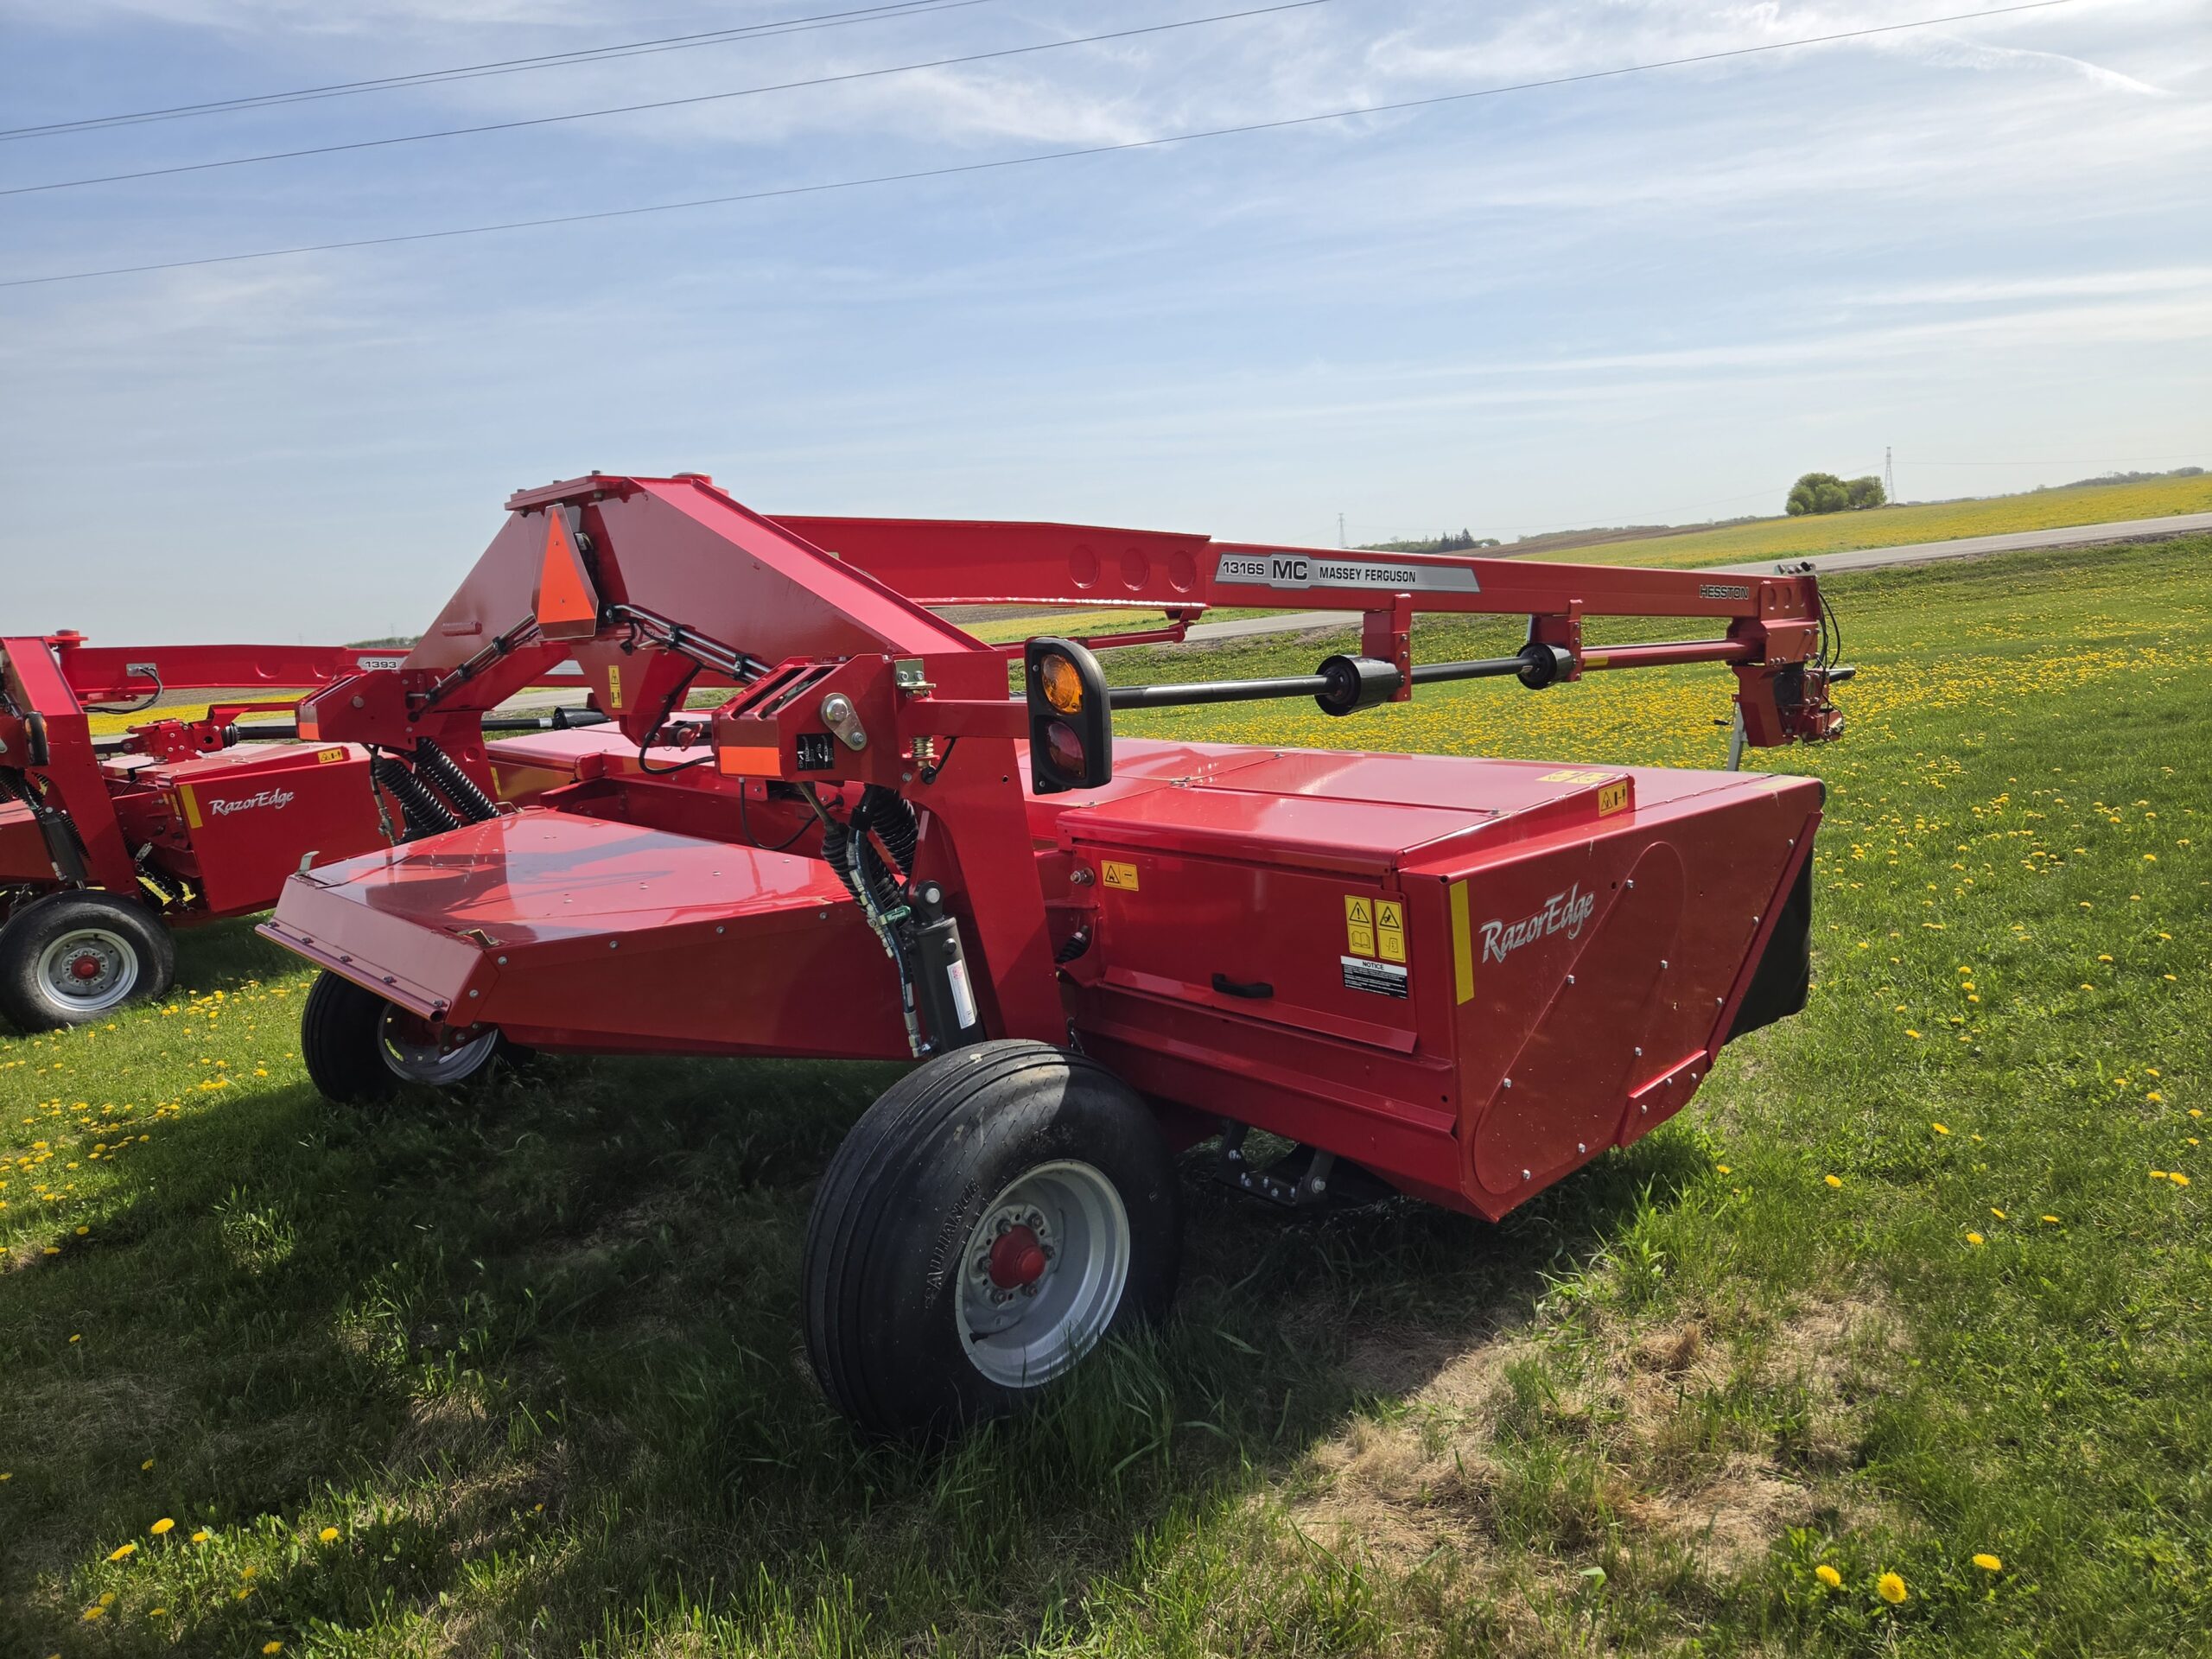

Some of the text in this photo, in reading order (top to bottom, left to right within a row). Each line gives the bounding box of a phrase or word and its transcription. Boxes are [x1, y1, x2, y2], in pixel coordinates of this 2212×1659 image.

[1222, 560, 1416, 583] 1316S MC MASSEY FERGUSON
[1700, 584, 1749, 601] HESSTON
[208, 787, 294, 817] RazorEdge
[1478, 880, 1595, 964] RazorEdge
[1362, 961, 1385, 971] NOTICE
